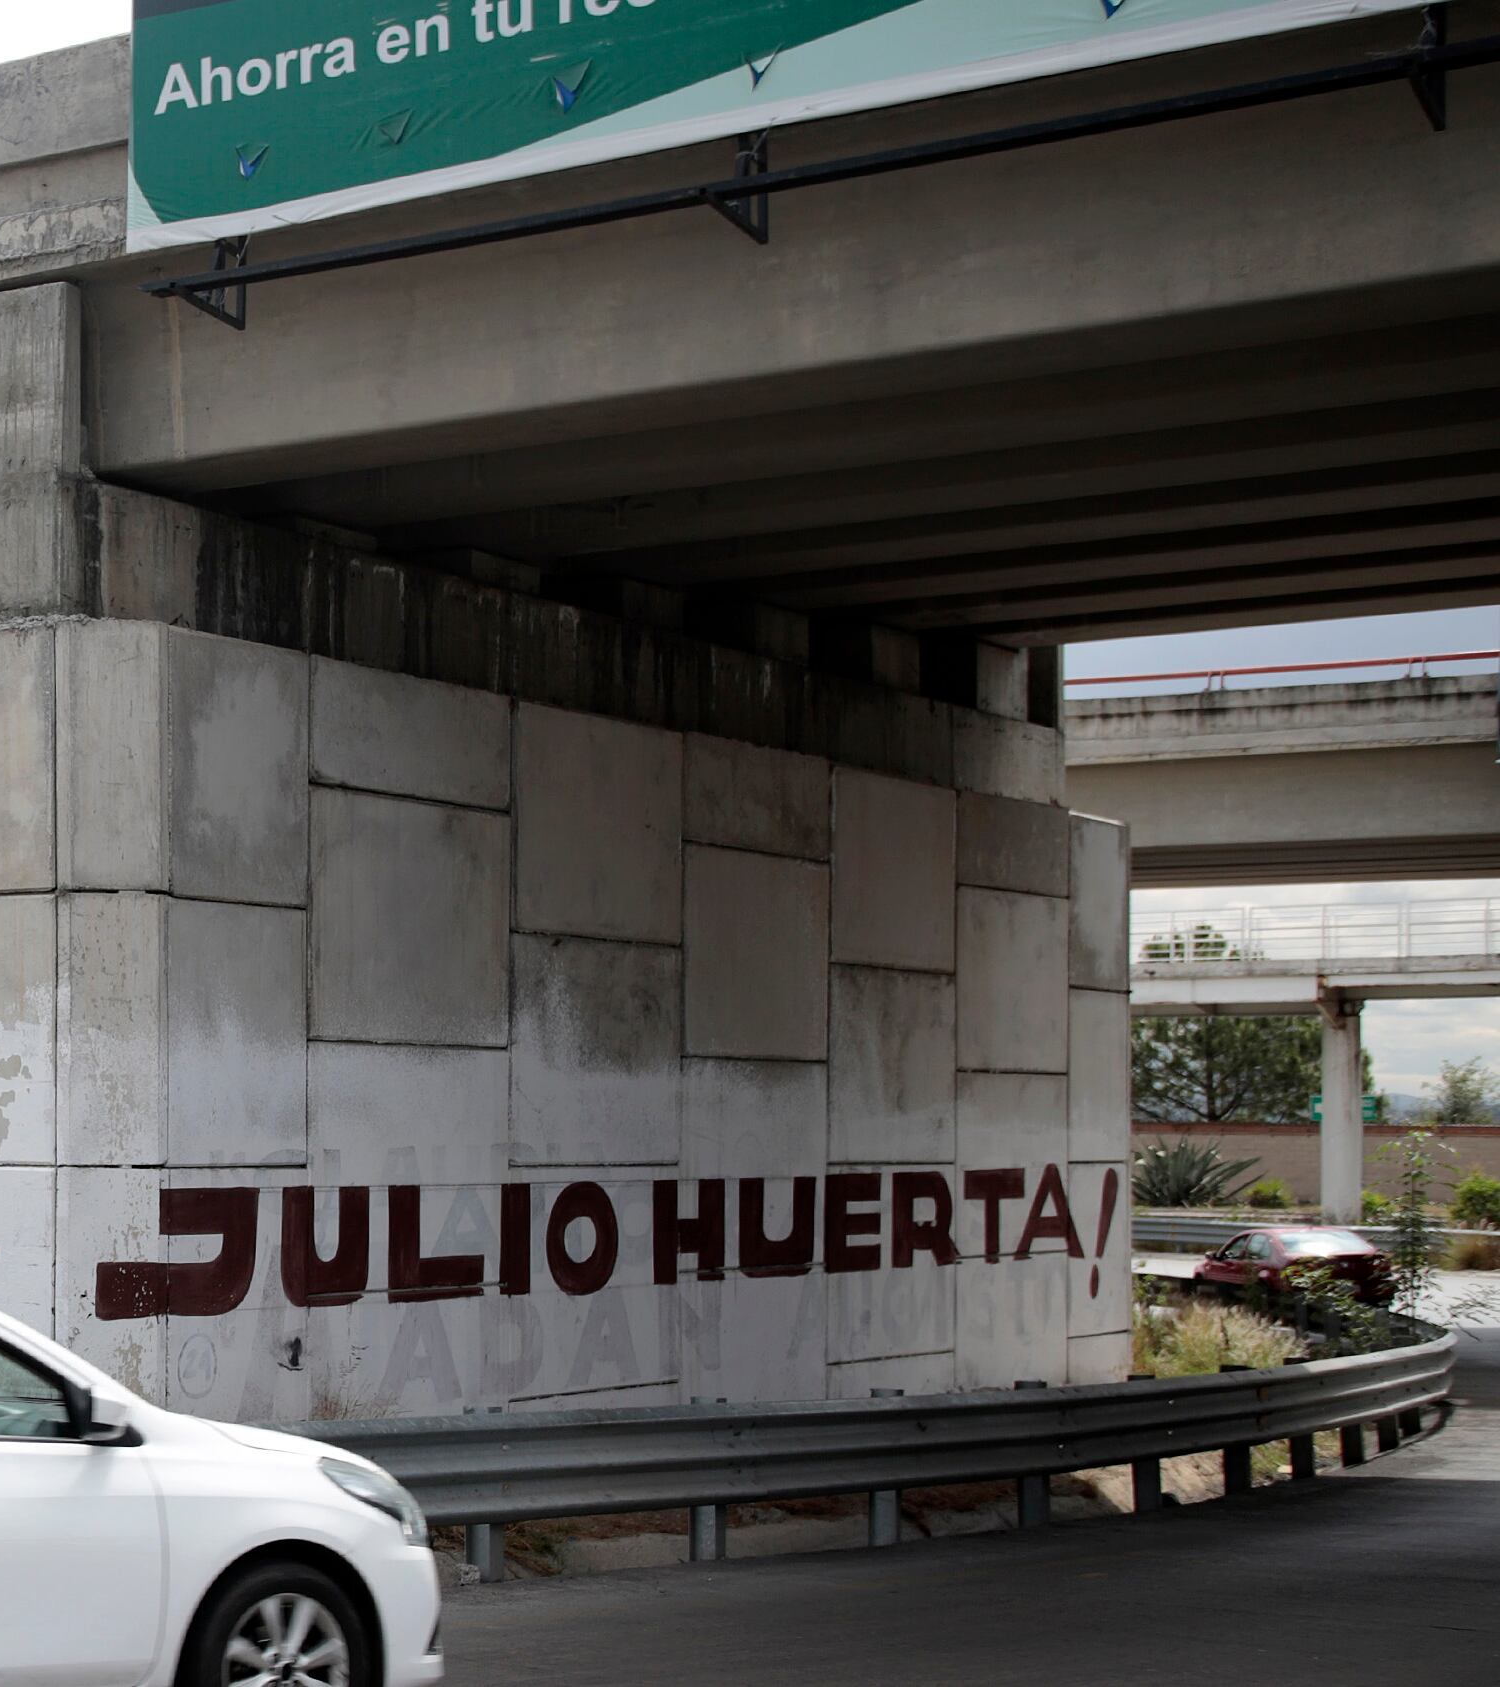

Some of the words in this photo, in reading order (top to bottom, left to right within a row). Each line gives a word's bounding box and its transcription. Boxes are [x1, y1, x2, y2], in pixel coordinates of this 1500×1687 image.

[153, 36, 357, 116] Ahorra
[376, 7, 449, 65] en
[471, 0, 533, 43] tu
[94, 1180, 619, 1320] JULIO
[652, 1162, 1119, 1299] HUERTA!
